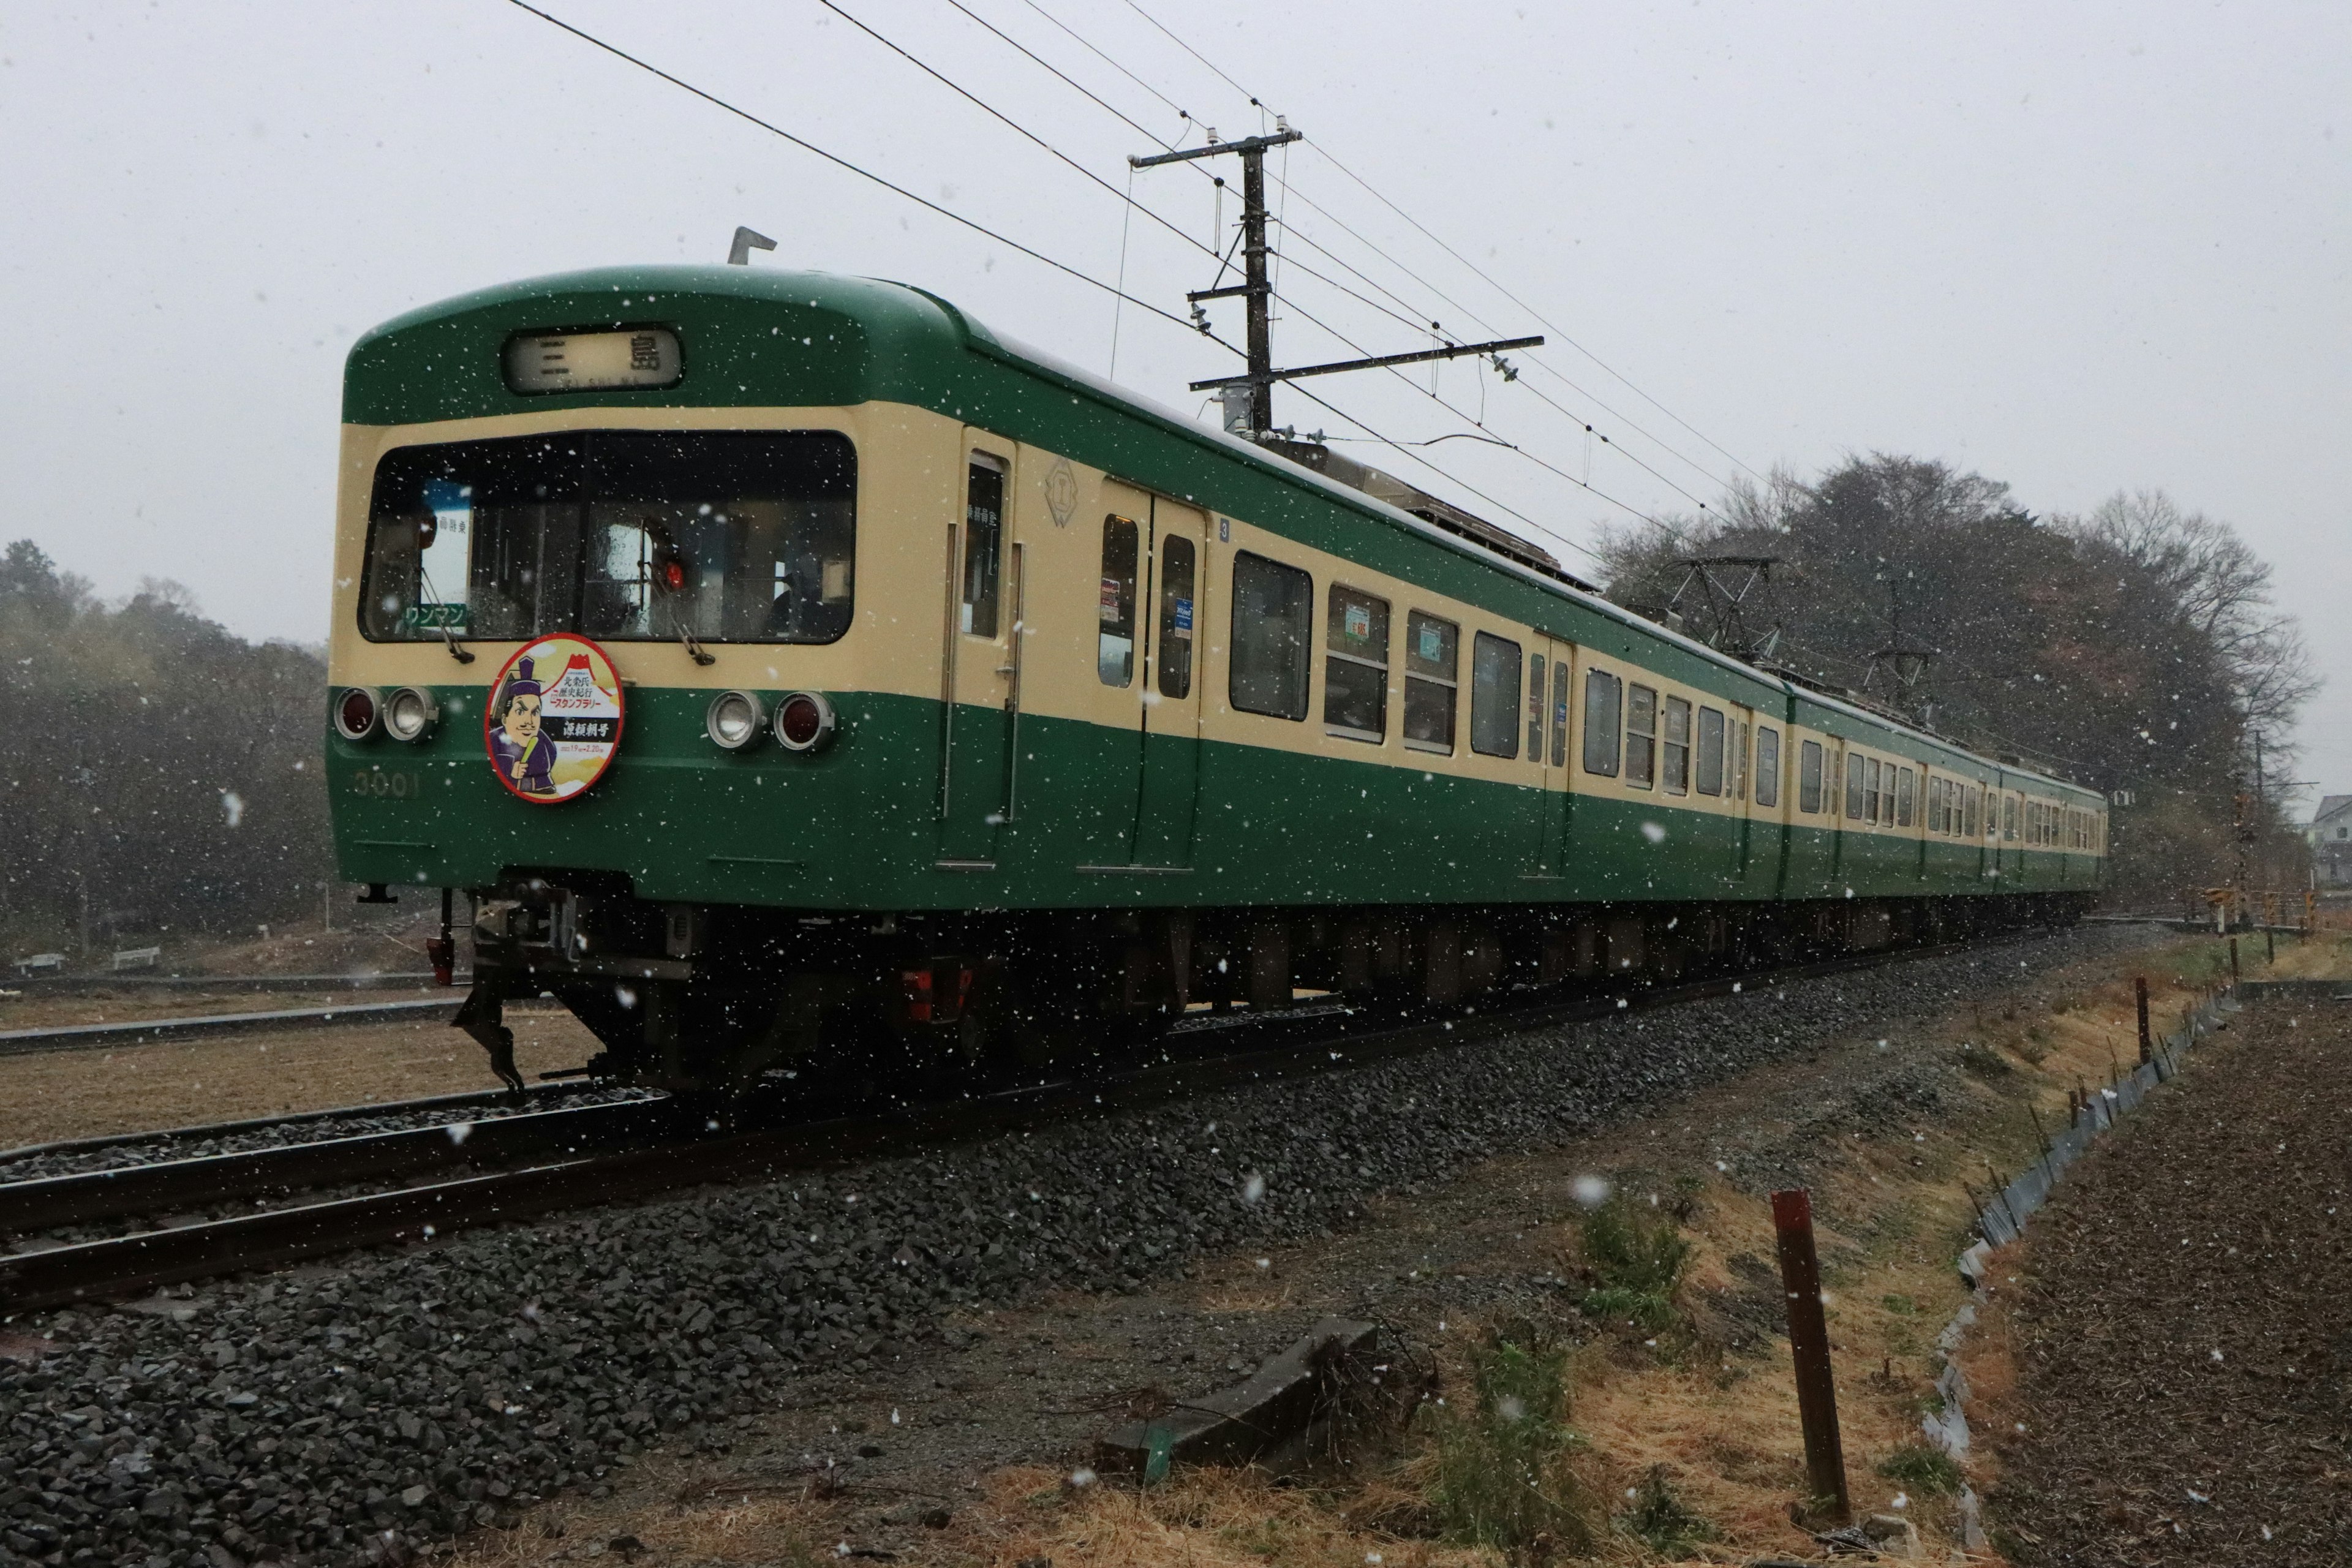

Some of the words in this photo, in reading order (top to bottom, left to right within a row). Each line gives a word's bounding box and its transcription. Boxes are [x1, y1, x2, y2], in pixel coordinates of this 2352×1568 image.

[406, 607, 464, 624] ワンマン
[564, 676, 590, 687] 北条氏
[559, 687, 593, 698] 歴史紀行
[354, 771, 418, 797] 3001
